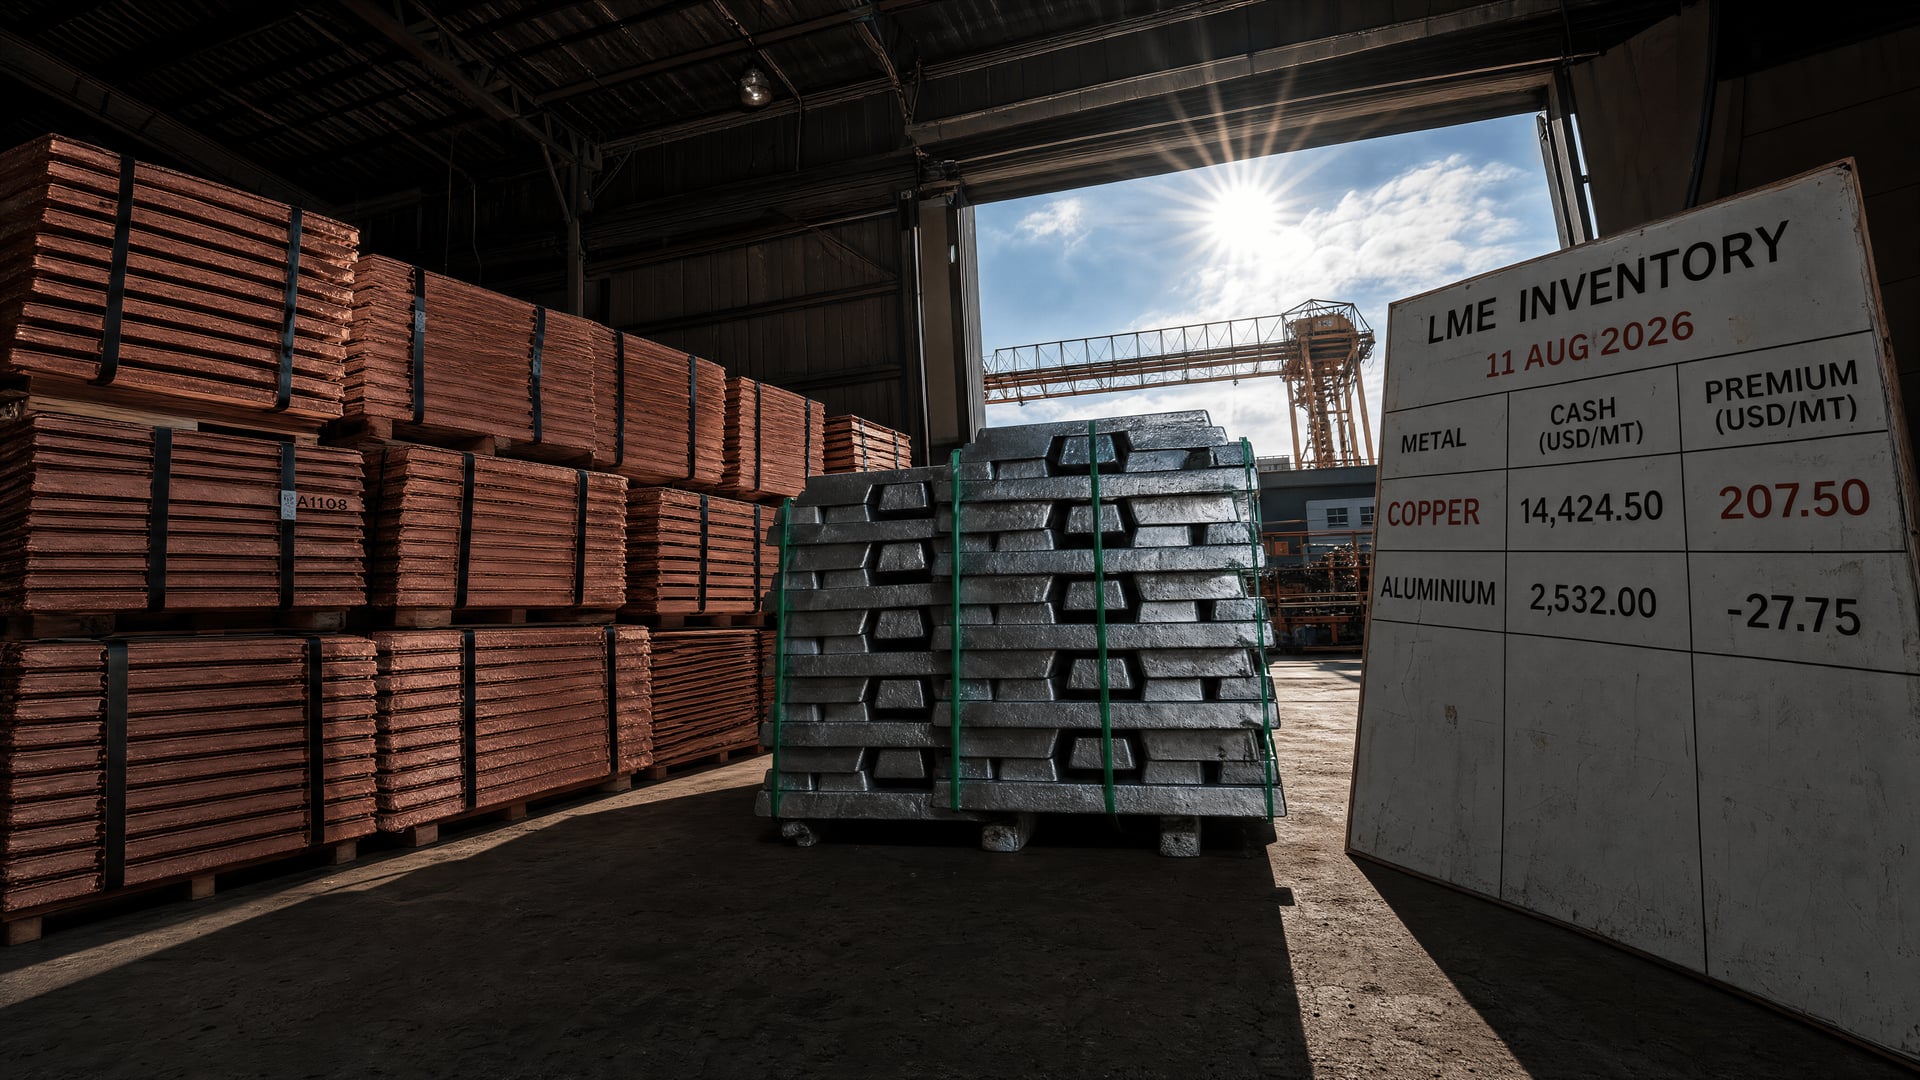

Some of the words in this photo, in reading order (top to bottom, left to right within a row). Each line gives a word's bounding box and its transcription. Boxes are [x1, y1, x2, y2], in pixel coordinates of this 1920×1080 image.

[1428, 296, 1497, 345] LME
[1519, 219, 1790, 323] INVENTORY
[1486, 350, 1515, 378] 11
[1524, 333, 1589, 371] AUG
[1600, 310, 1694, 356] 2026
[1705, 359, 1858, 404] PREMIUM
[1550, 396, 1616, 425] CASH
[1715, 393, 1857, 435] (USD/MT)
[1401, 427, 1467, 454] METAL
[1539, 419, 1644, 455] (USD/MT)
[296, 495, 348, 511] A1108
[1387, 498, 1480, 527] COPPER
[1520, 490, 1663, 529] 14,424.50
[1719, 478, 1870, 520] 207.50
[1380, 575, 1496, 606] ALUMINIUM
[1529, 583, 1657, 619] 2,532.00
[1727, 593, 1862, 637] -27.75
